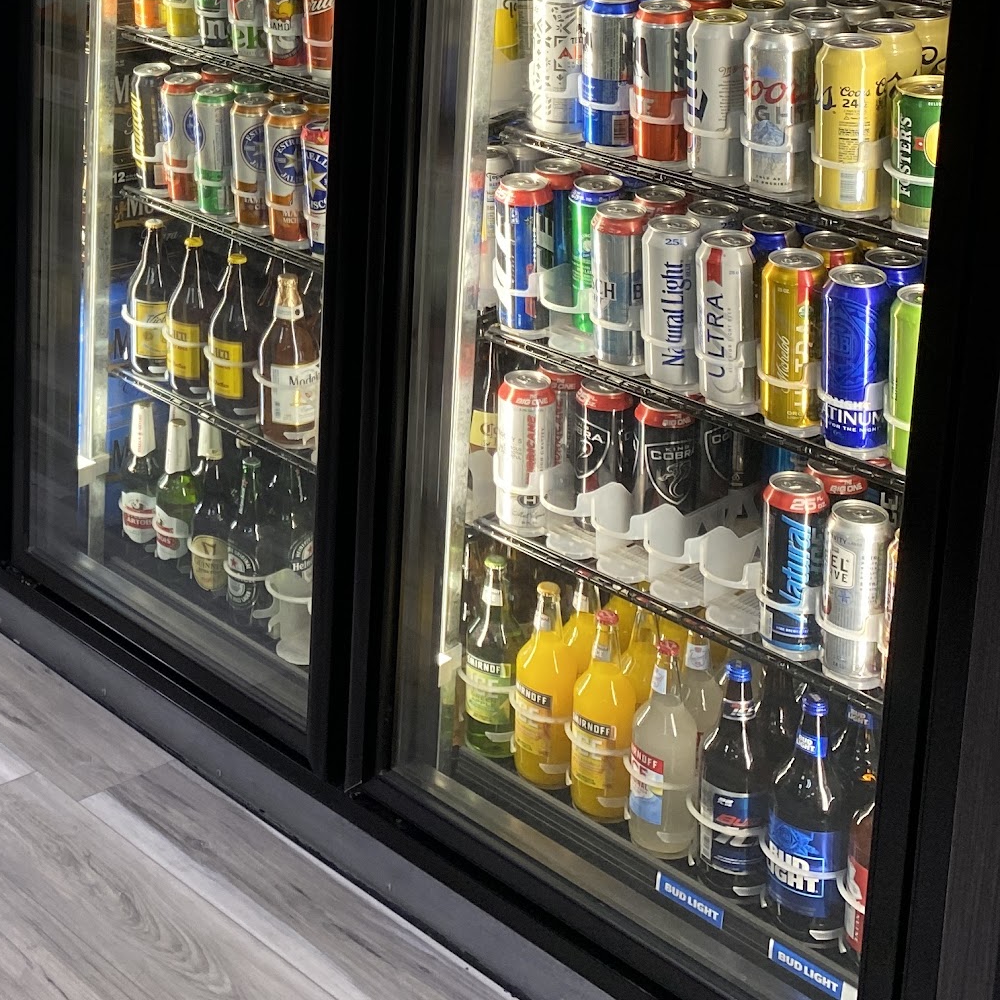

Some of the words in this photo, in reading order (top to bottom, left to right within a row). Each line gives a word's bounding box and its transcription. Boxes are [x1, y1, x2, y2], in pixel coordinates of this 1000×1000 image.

[839, 86, 871, 98] Coors
[842, 98, 858, 109] 24
[661, 261, 691, 308] Light
[661, 311, 686, 367] Natural
[707, 292, 726, 379] ULTRA
[775, 334, 790, 394] Michelob
[516, 397, 531, 405] BIG
[532, 397, 549, 405] ONE
[662, 418, 677, 427] BIG
[677, 416, 692, 426] ONE
[822, 407, 885, 426] ATINUM
[650, 449, 695, 462] COBRA
[665, 445, 691, 453] KING
[829, 484, 847, 494] BIG
[847, 482, 863, 493] ONE
[778, 514, 813, 621] Natural
[848, 712, 869, 726] LIGHT
[850, 708, 867, 720] BUD
[796, 739, 816, 753] LIGHT
[798, 734, 814, 746] BUD
[769, 840, 810, 872] BUD
[664, 882, 687, 903] BUD
[687, 894, 720, 922] LIGHT
[777, 951, 803, 972] BUD
[803, 965, 839, 993] LIGHT
